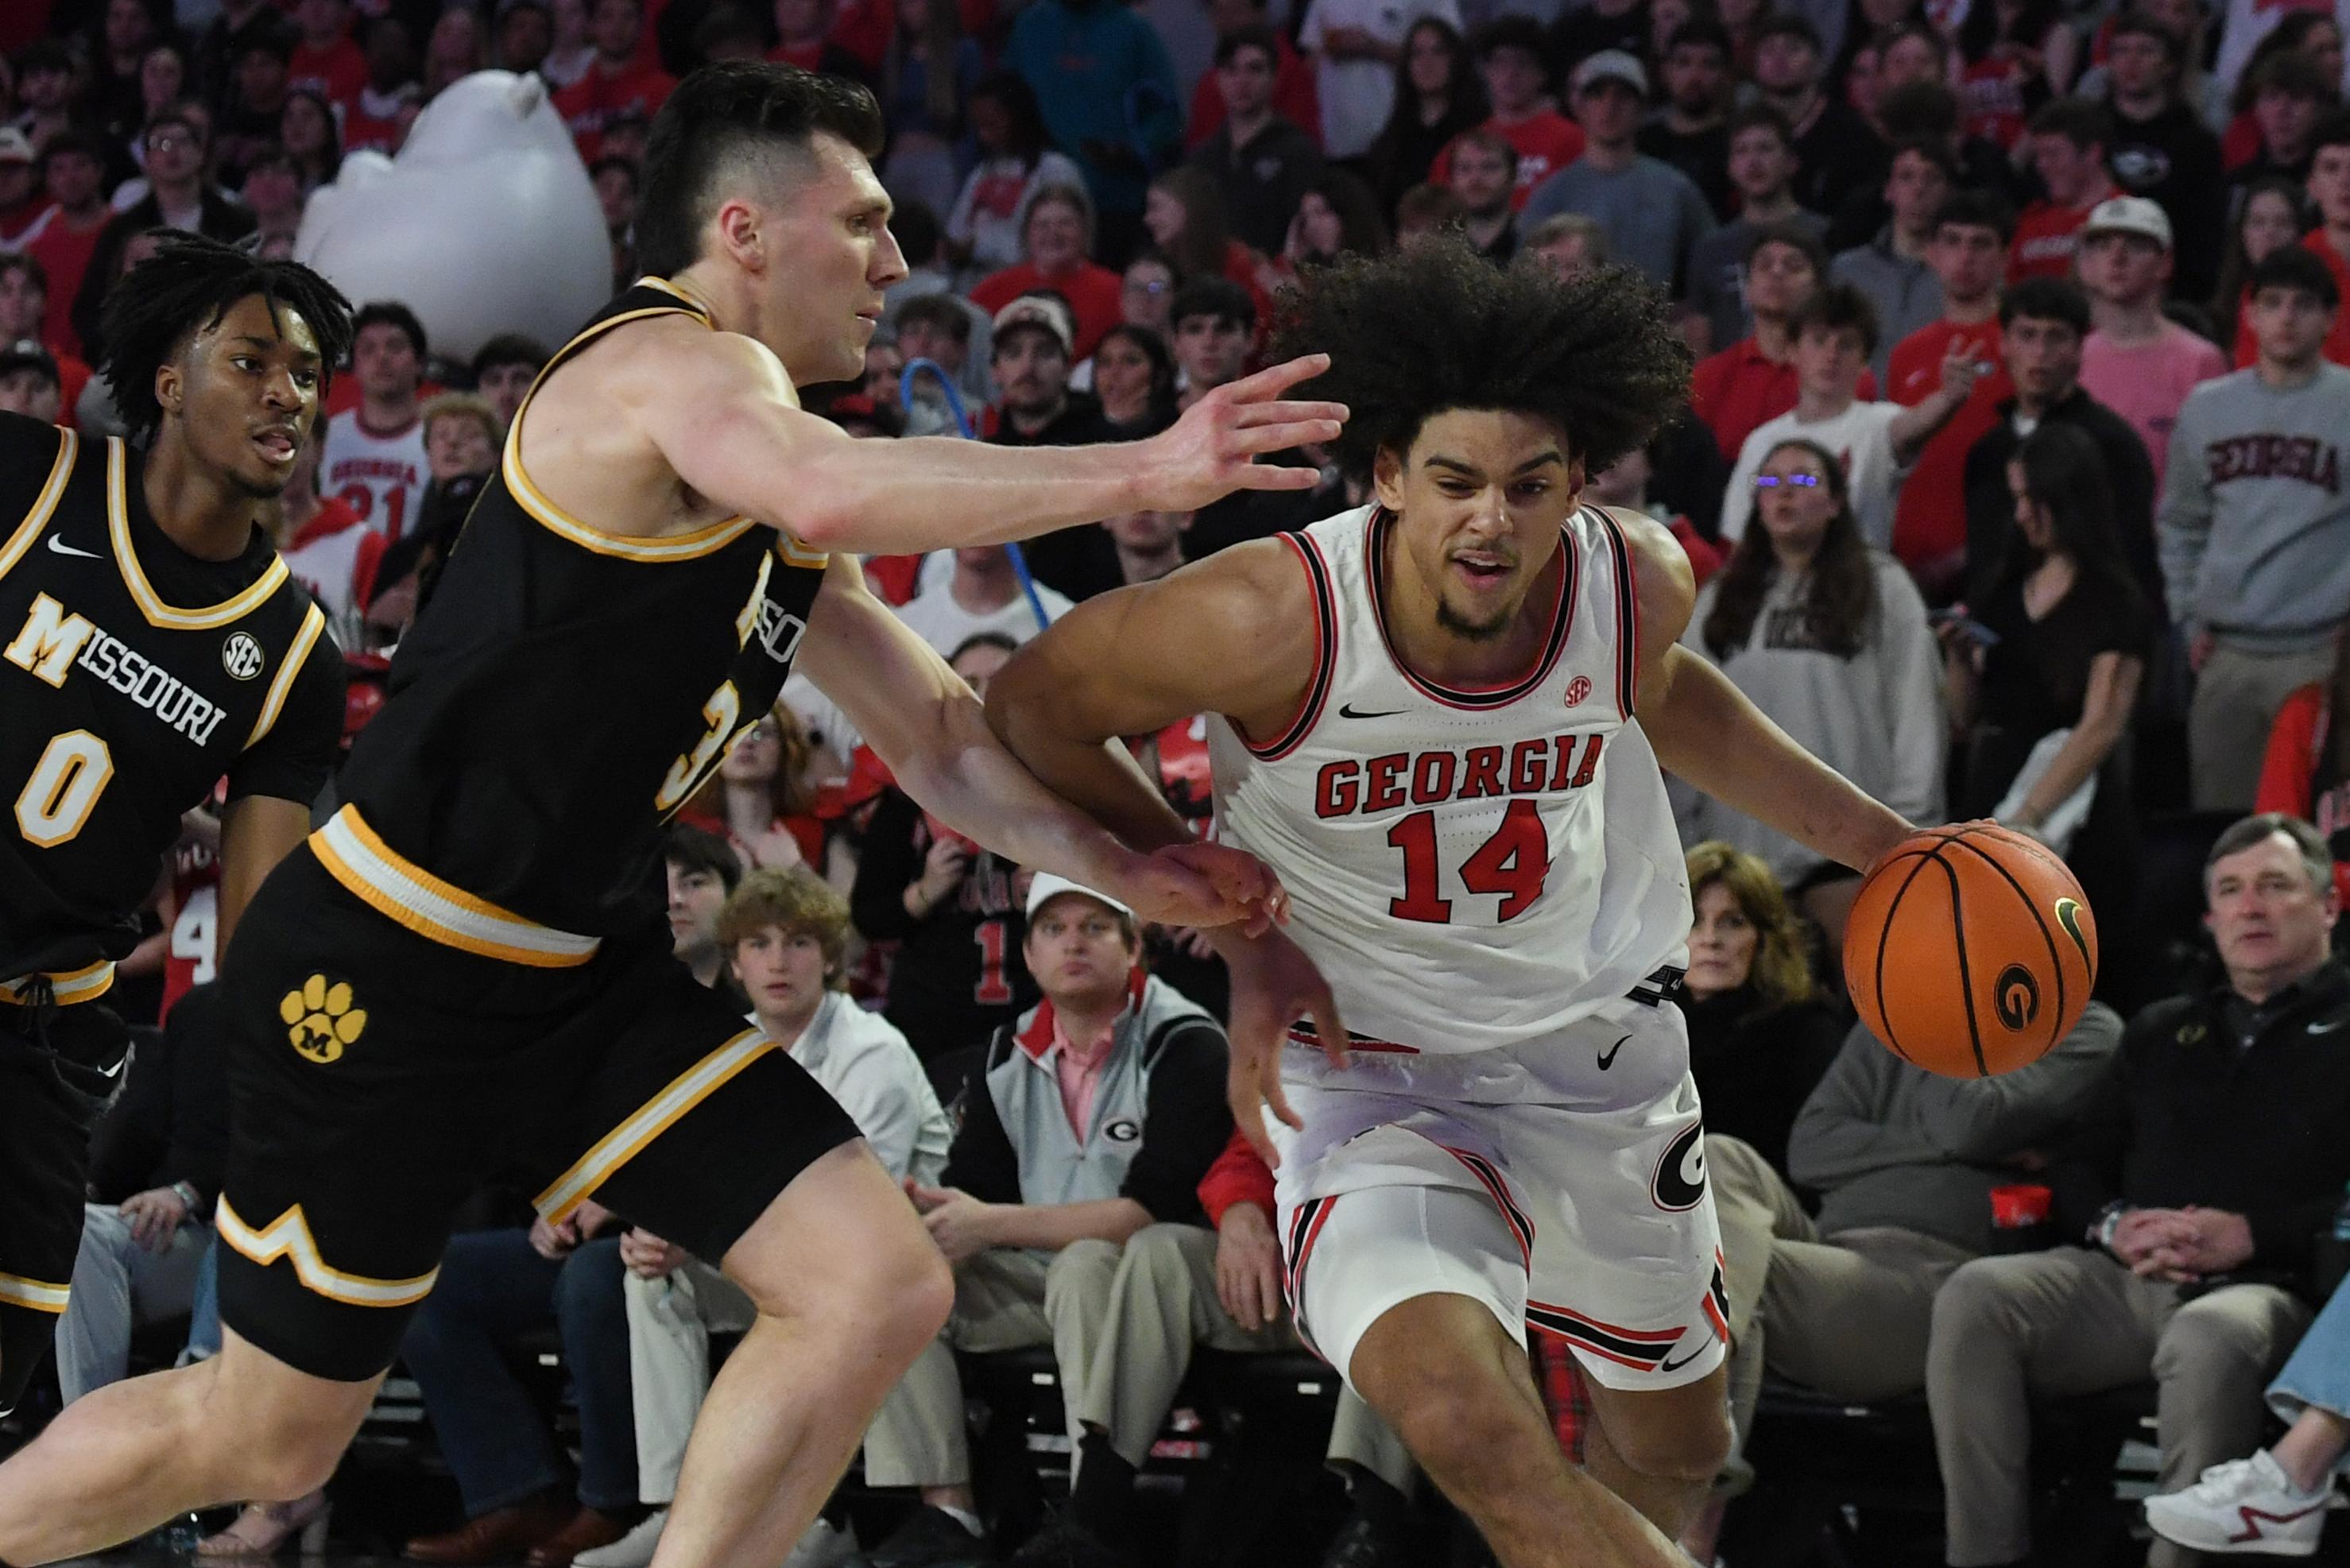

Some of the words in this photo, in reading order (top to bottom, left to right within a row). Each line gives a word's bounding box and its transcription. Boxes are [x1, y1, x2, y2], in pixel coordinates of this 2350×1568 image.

[2, 590, 227, 747] MISSOURI
[224, 633, 263, 678] SEC
[1566, 678, 1590, 706] SEC
[13, 727, 115, 849] 0
[1314, 734, 1603, 819] GEORGIA
[1387, 799, 1555, 923] 14
[170, 884, 218, 985] 4
[974, 920, 1015, 1006] 1
[1996, 966, 2038, 1030] G
[300, 1025, 331, 1058] M
[1104, 1119, 1140, 1144] G
